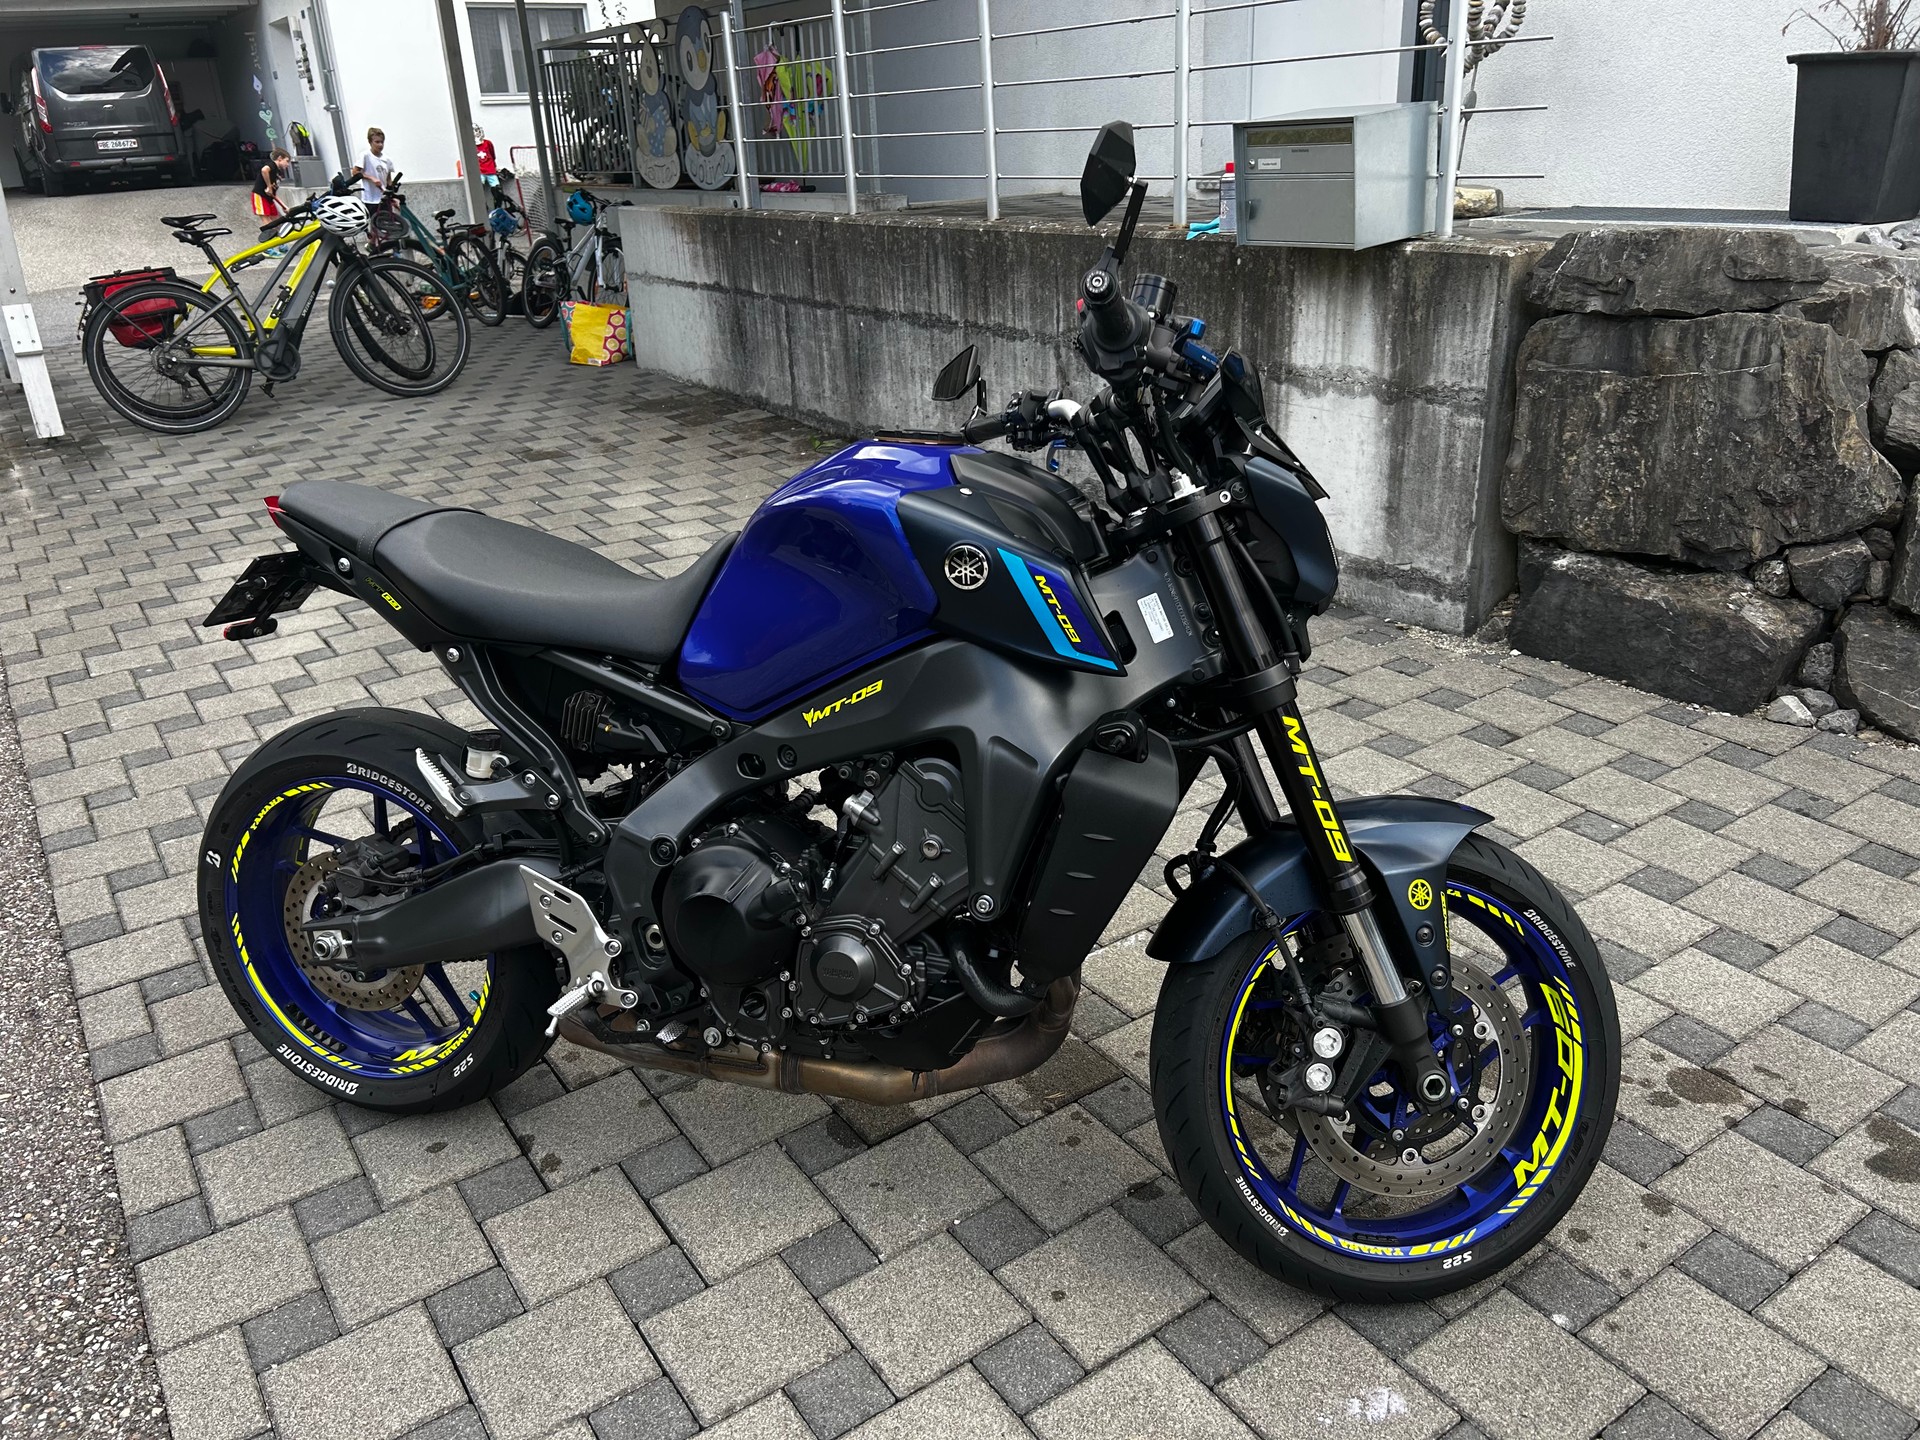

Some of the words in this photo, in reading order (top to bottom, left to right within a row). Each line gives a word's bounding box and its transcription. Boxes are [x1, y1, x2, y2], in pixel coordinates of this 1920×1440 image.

[1034, 575, 1081, 643] MT-09
[812, 679, 883, 723] MT-09
[250, 796, 284, 831] YAMAHA
[346, 762, 433, 814] BRIDGESTONE
[1281, 715, 1353, 862] MT-09
[1523, 909, 1577, 969] BRIDGESTONE
[276, 1043, 360, 1096] BRIDGESTONE
[452, 1052, 474, 1078] S22
[1513, 982, 1573, 1189] MT-09
[1234, 1175, 1289, 1237] BRIDGESTONE
[1442, 1250, 1473, 1270] S22
